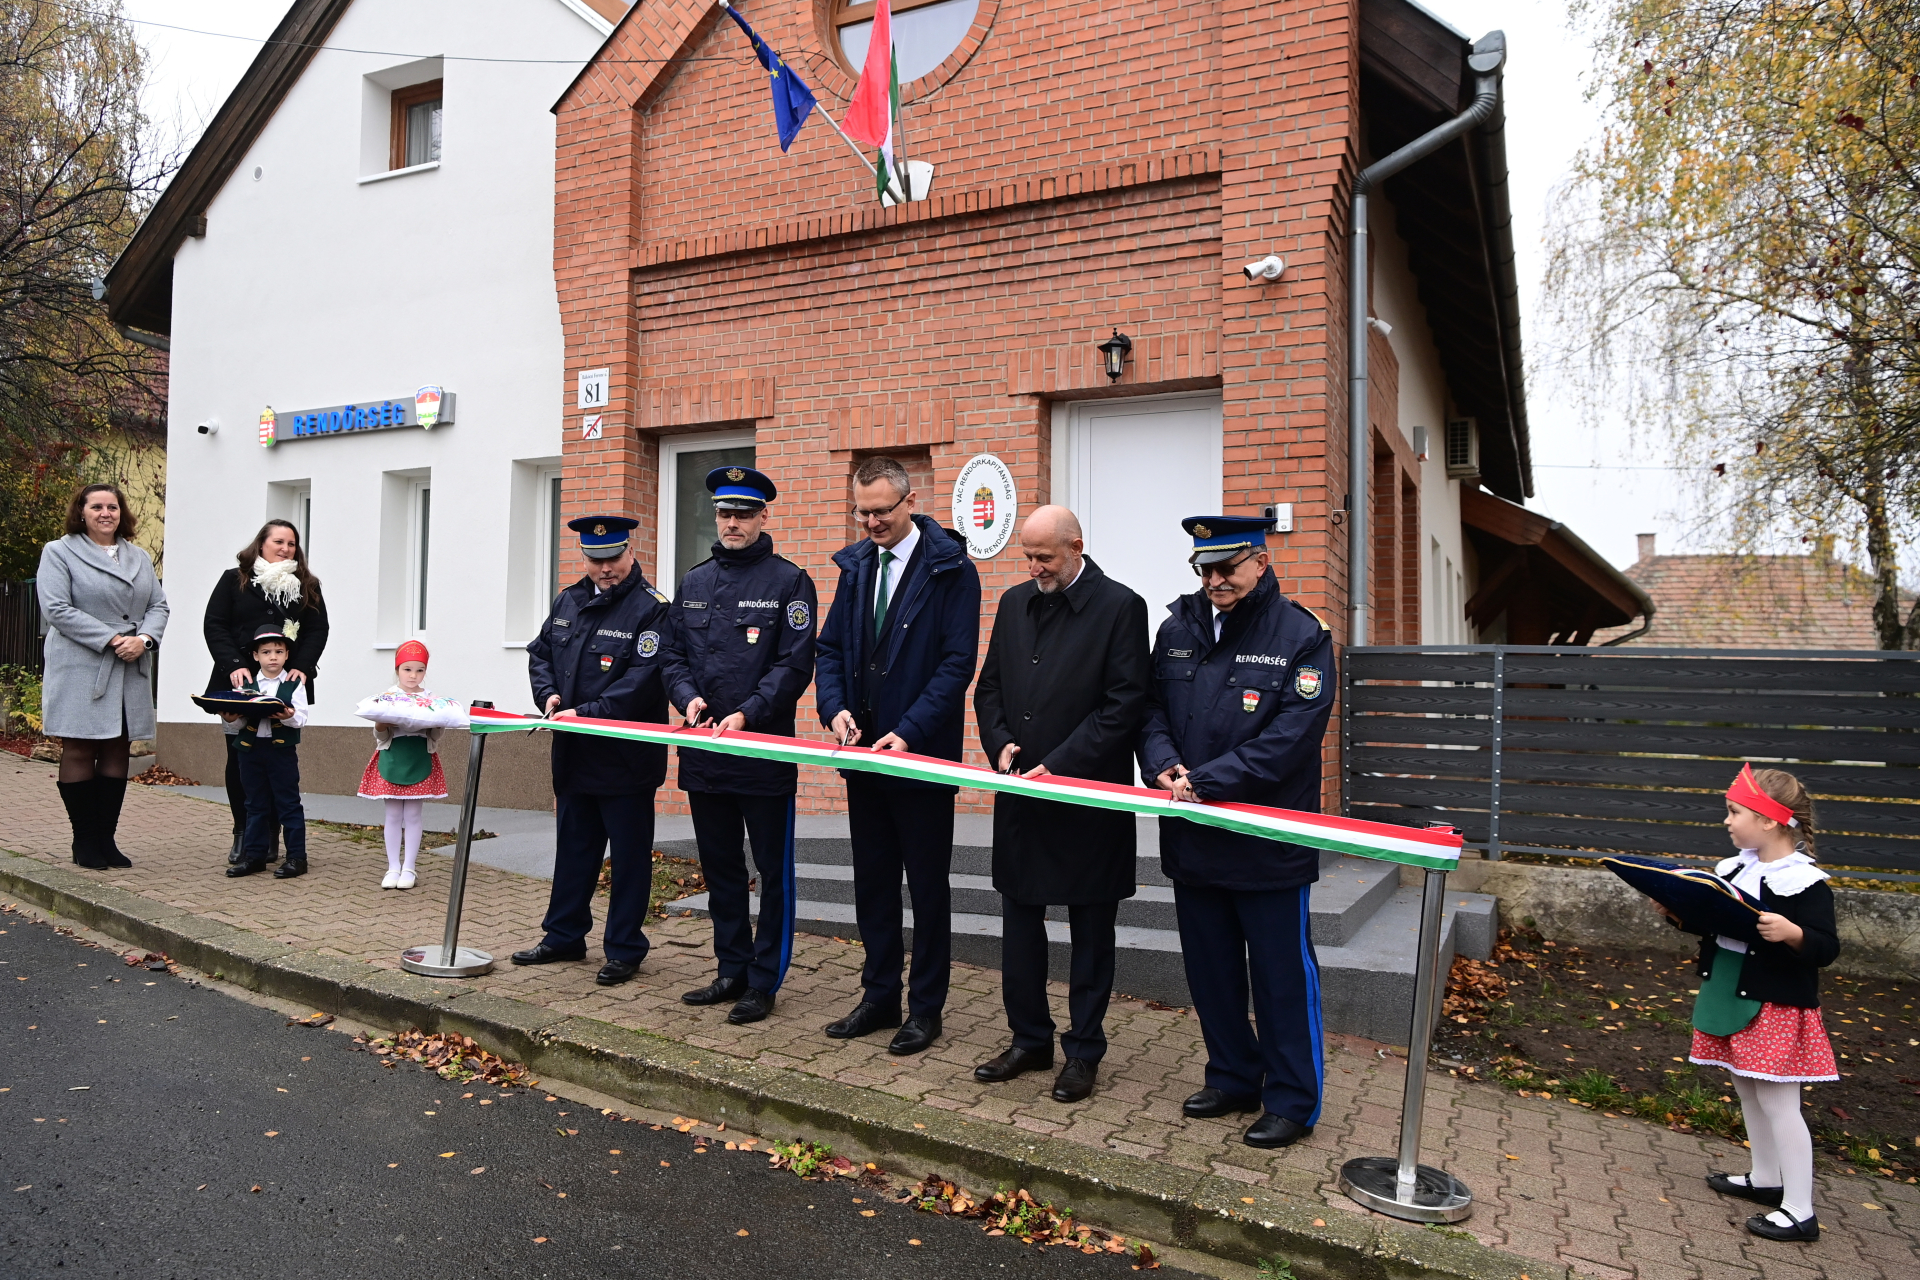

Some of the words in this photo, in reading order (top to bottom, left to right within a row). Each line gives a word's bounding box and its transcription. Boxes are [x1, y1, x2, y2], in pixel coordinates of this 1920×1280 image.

[585, 382, 601, 403] 81
[293, 401, 404, 435] RENDŐRSÉG
[959, 458, 1012, 500] RENDŐRKAPITÁNYSÁG
[956, 487, 964, 504] VÁC
[983, 512, 1012, 555] RENDŐRŐRS
[737, 598, 779, 609] RENDŐRSÉG
[596, 629, 633, 640] RENDŐRSG
[1235, 654, 1288, 667] RENDŐRSÉG
